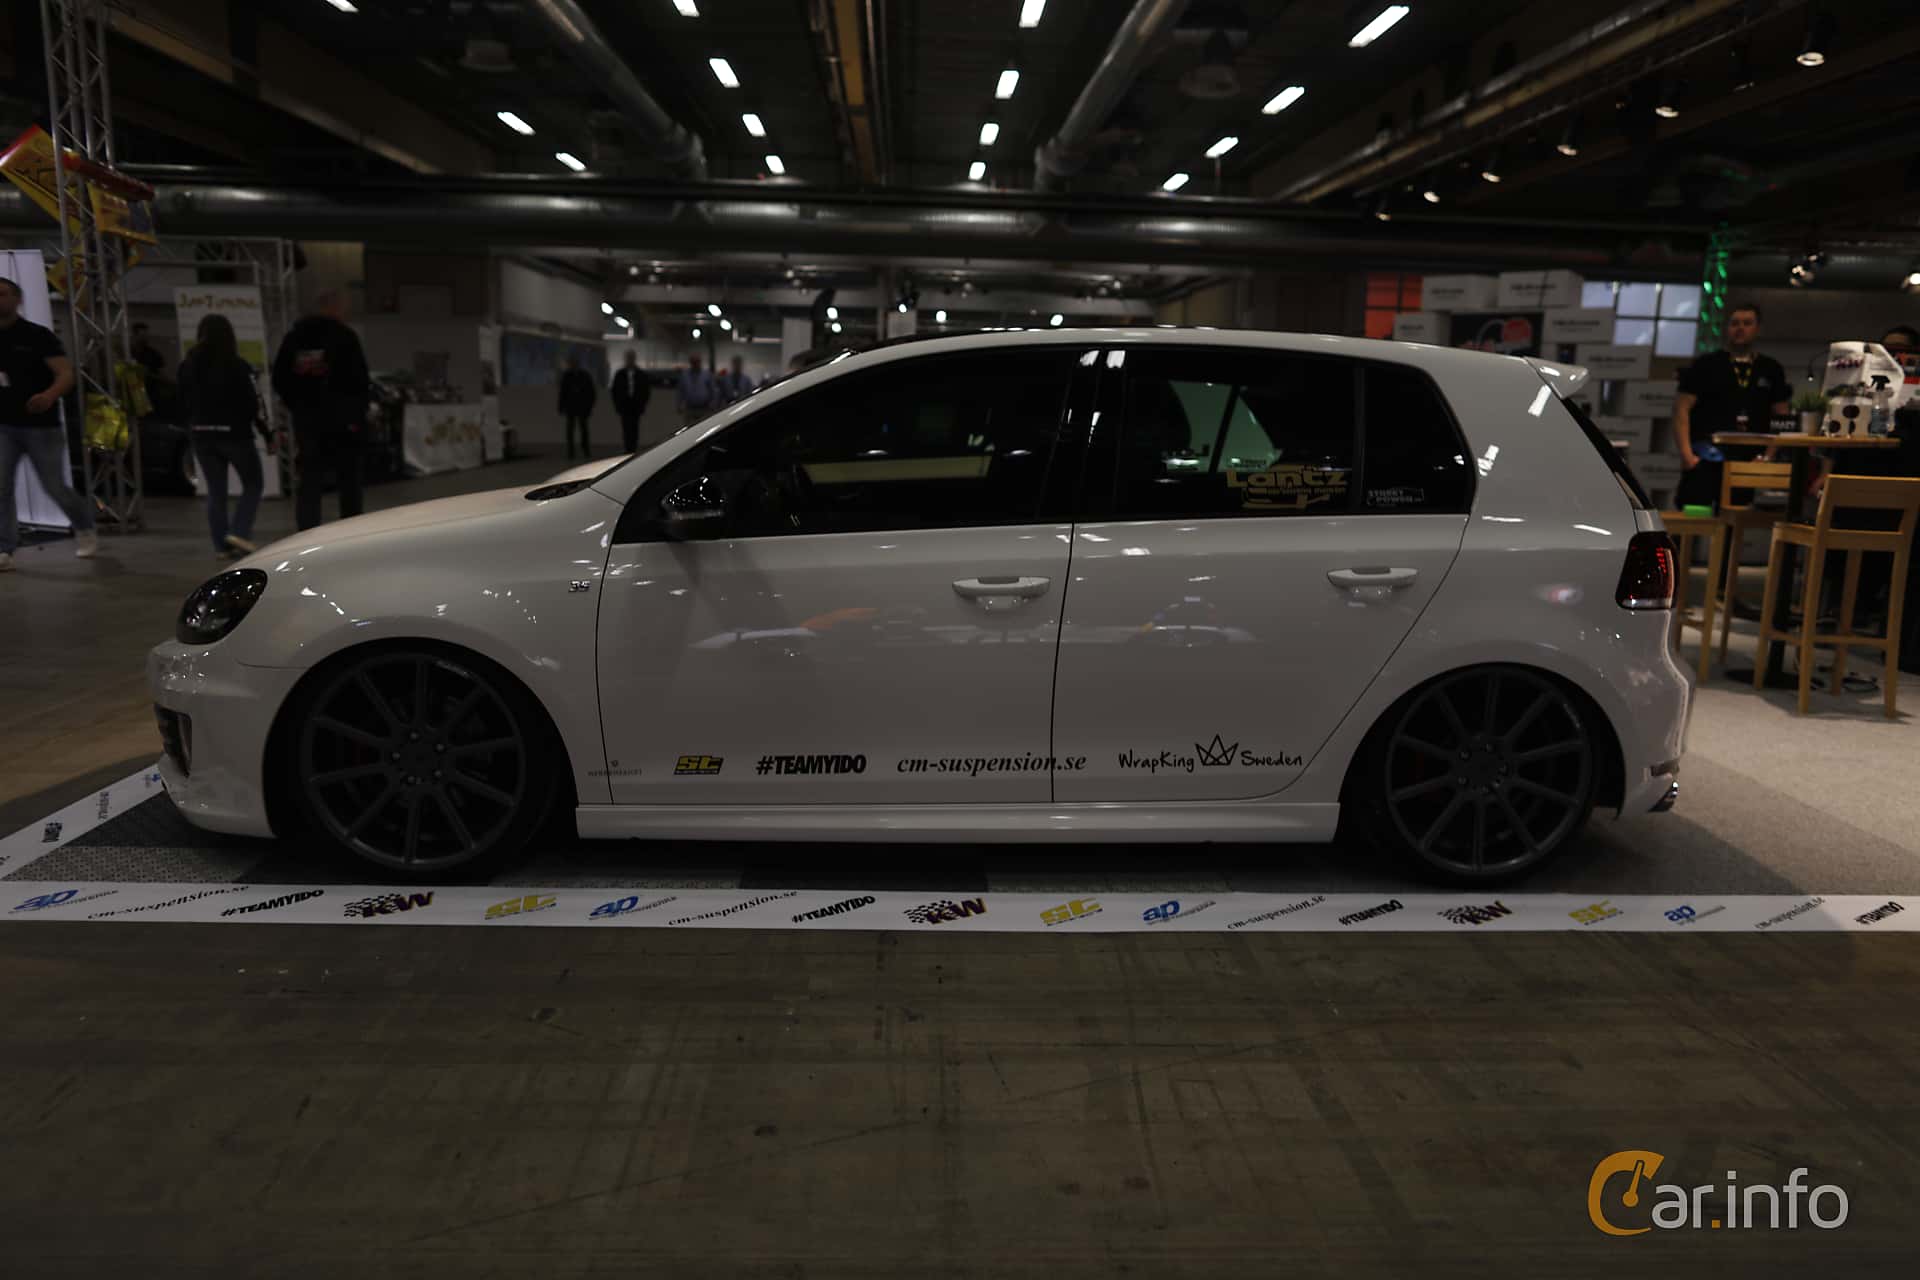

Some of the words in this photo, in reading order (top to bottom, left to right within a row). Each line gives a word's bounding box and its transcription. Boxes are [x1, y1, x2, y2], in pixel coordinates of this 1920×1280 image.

[756, 755, 866, 775] #TEAMYIDO
[897, 752, 1087, 777] cm-suspension.se
[1118, 749, 1195, 773] WrapKing
[1241, 751, 1303, 766] Sweden
[87, 885, 249, 920] cm-suspension.se
[221, 889, 324, 917] #TEAMYIDO
[668, 891, 798, 926] cm-suspension.se
[791, 894, 876, 924] #TEAMYIDO
